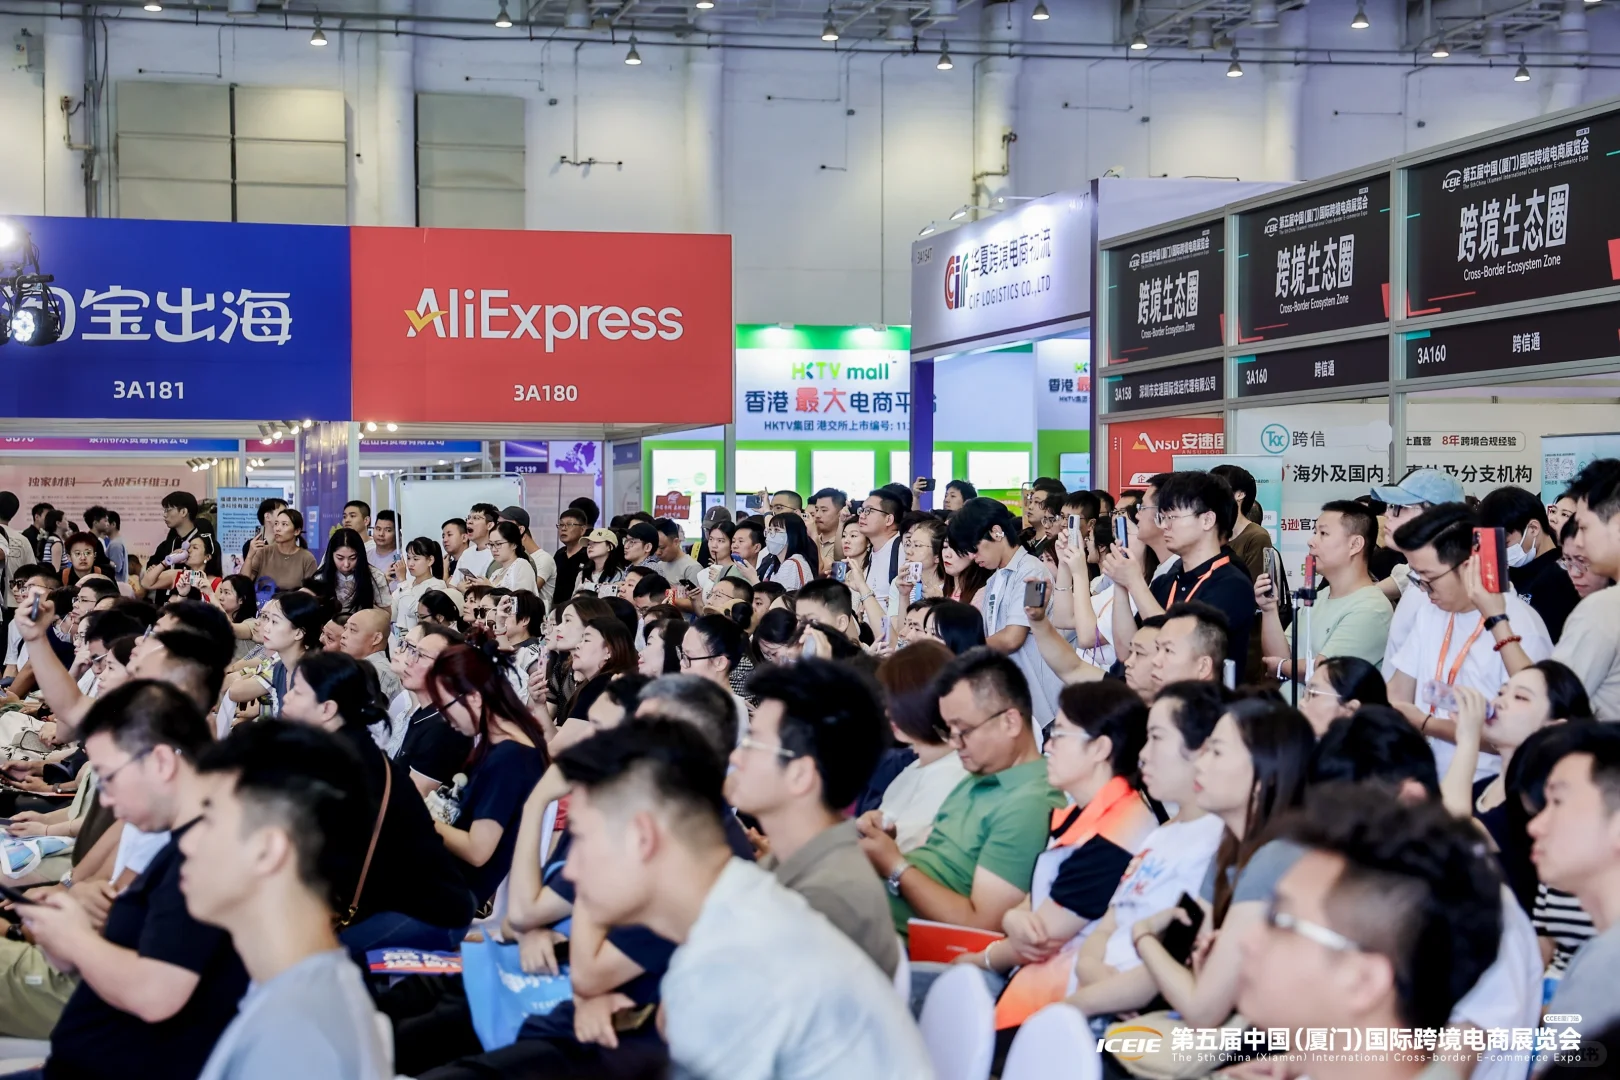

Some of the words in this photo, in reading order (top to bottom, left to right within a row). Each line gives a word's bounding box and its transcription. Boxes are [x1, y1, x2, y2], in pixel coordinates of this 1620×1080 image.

[1457, 183, 1570, 263] 跨境生态圈
[1275, 233, 1354, 298] 跨境生态圈
[1464, 263, 1506, 281] Cross-Border
[1507, 258, 1543, 275] Ecosystem
[1543, 254, 1561, 267] Zone
[969, 293, 980, 310] CIF
[982, 282, 1019, 307] LOGISTICS
[1138, 269, 1200, 325] 跨境生态圈
[1279, 299, 1310, 314] Cross-Border
[1311, 295, 1336, 311] Ecosystem
[1336, 294, 1349, 305] Zone
[403, 287, 684, 353] AliExpress
[1512, 332, 1541, 353] 跨信通
[1417, 344, 1447, 365] 3A160
[791, 362, 842, 380] HKTV
[847, 363, 889, 380] mall
[1246, 368, 1268, 386] 3A160
[1314, 360, 1335, 378] 跨信通
[113, 380, 185, 400] 3A181
[513, 384, 578, 402] 3A180
[1115, 386, 1132, 401] 3A158
[1139, 375, 1216, 399] 深圳市安速国际货运代理有限公司
[1292, 430, 1325, 447] 跨信
